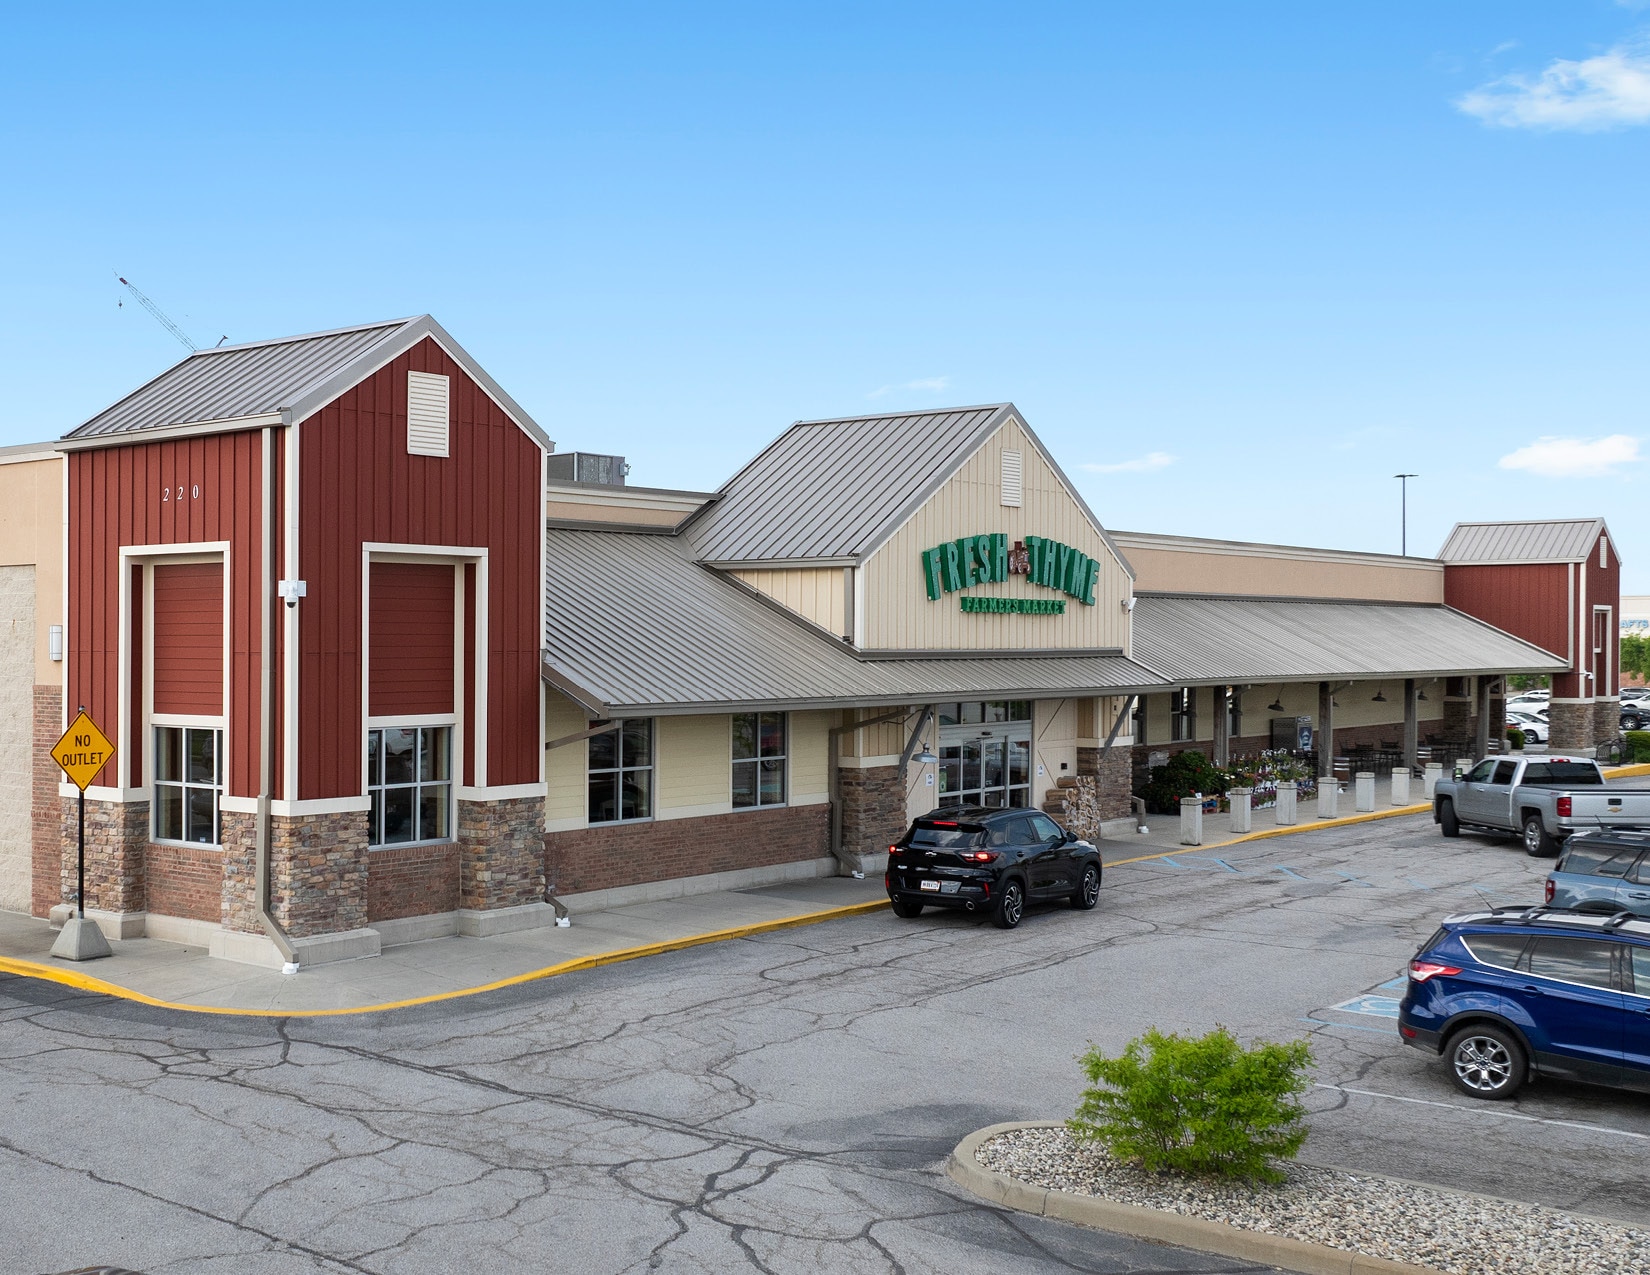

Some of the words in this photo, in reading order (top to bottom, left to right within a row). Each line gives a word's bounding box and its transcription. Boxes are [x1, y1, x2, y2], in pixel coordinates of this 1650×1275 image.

[162, 484, 199, 502] 220
[922, 533, 1008, 601] FRESH
[1026, 536, 1100, 606] THYME
[962, 597, 1019, 613] FARMERS
[1022, 599, 1066, 615] MARKET
[75, 735, 91, 747] NO
[62, 752, 103, 767] OUTLET
